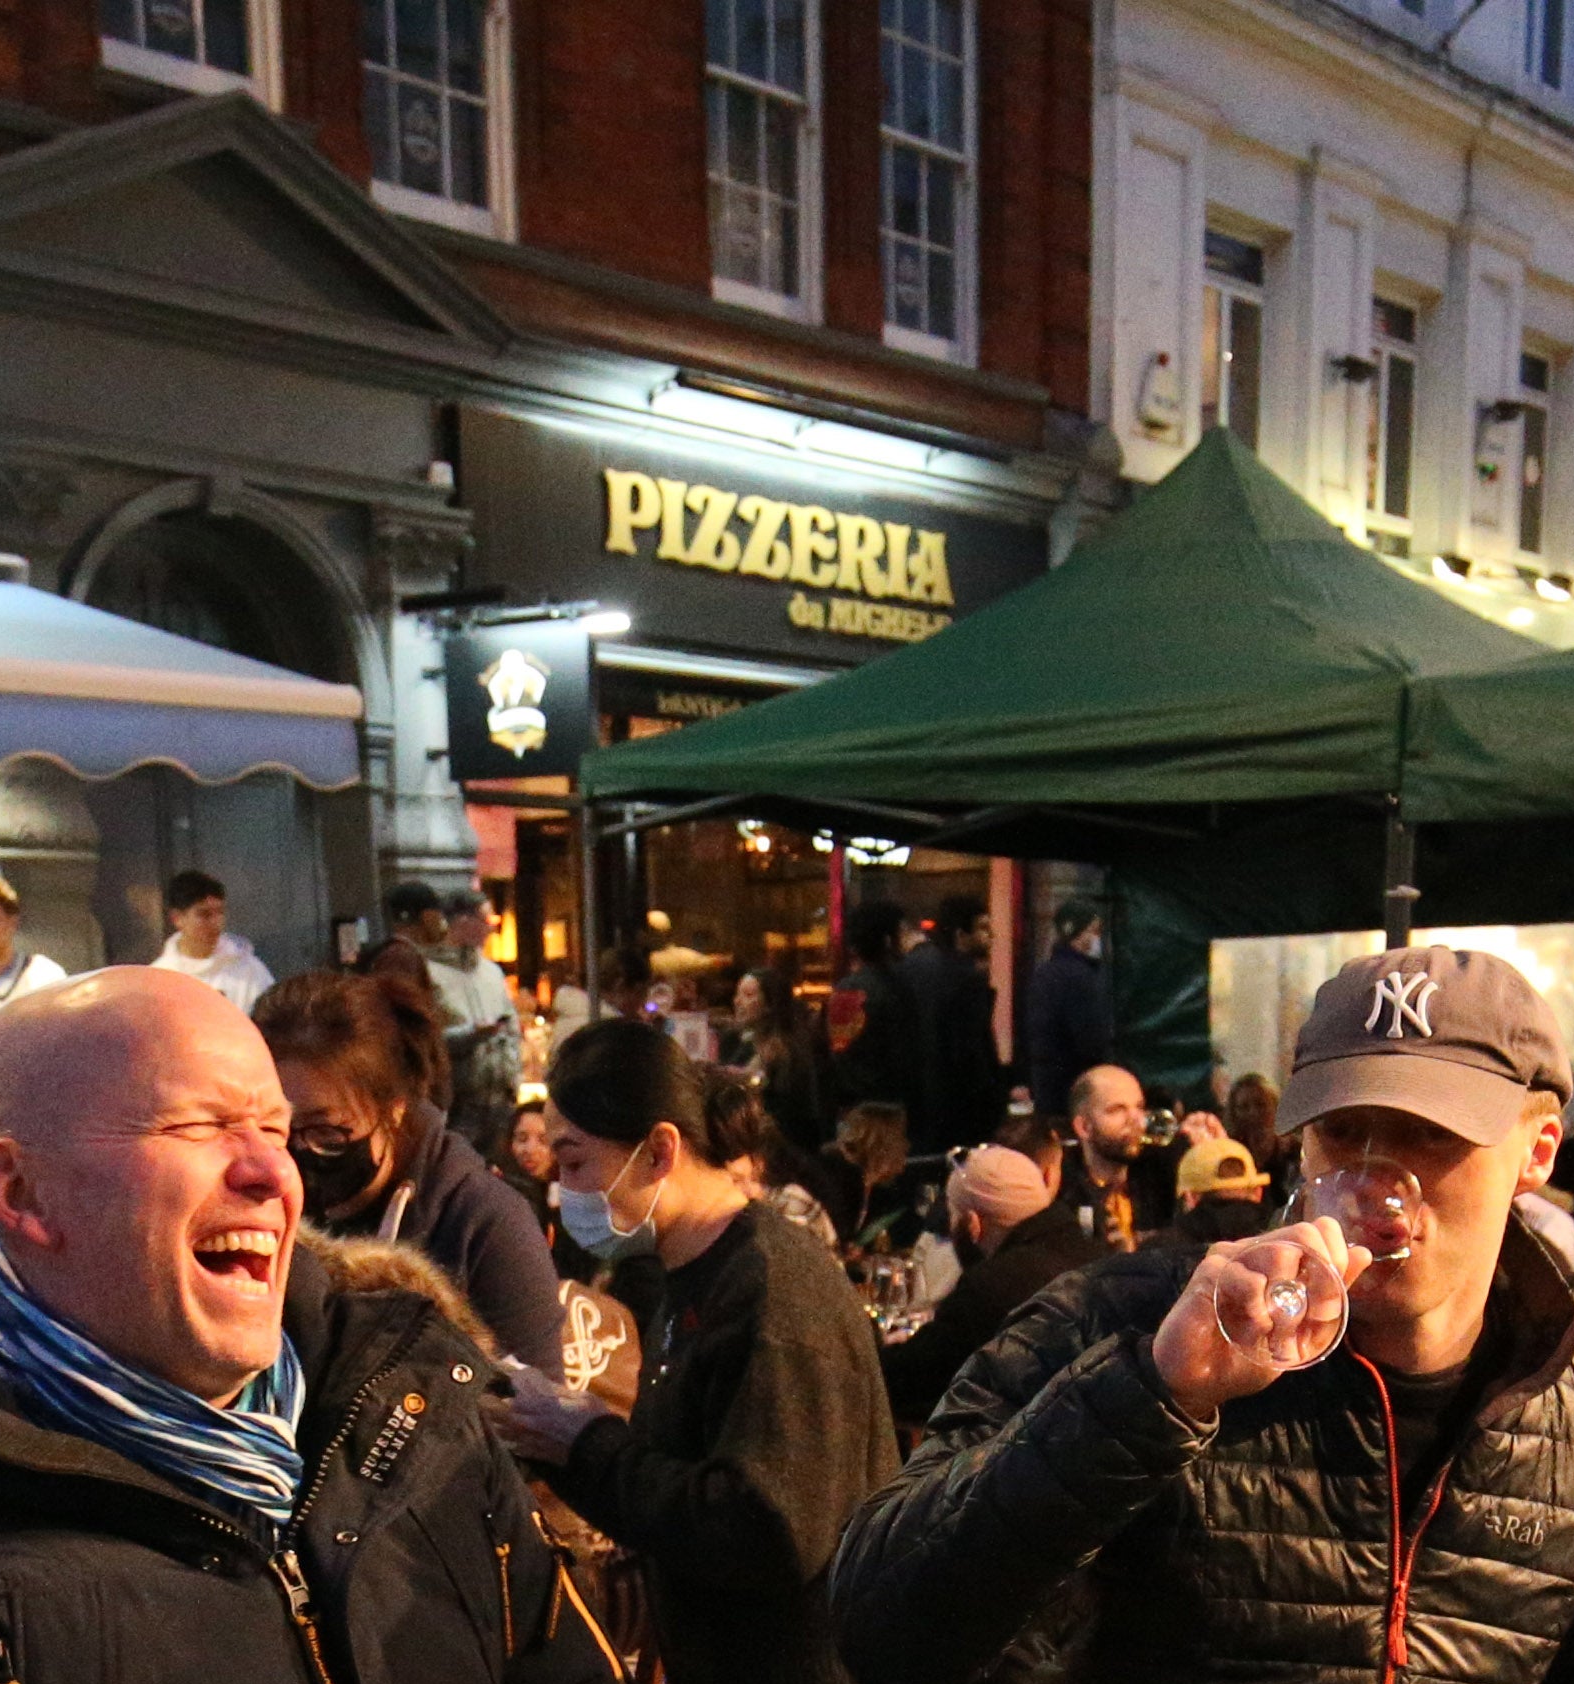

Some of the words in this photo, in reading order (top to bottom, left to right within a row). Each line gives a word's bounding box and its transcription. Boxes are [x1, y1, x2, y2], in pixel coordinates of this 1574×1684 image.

[603, 468, 955, 607] PIZZERIA
[1364, 970, 1439, 1039] NY
[1501, 1514, 1545, 1547] Rab
